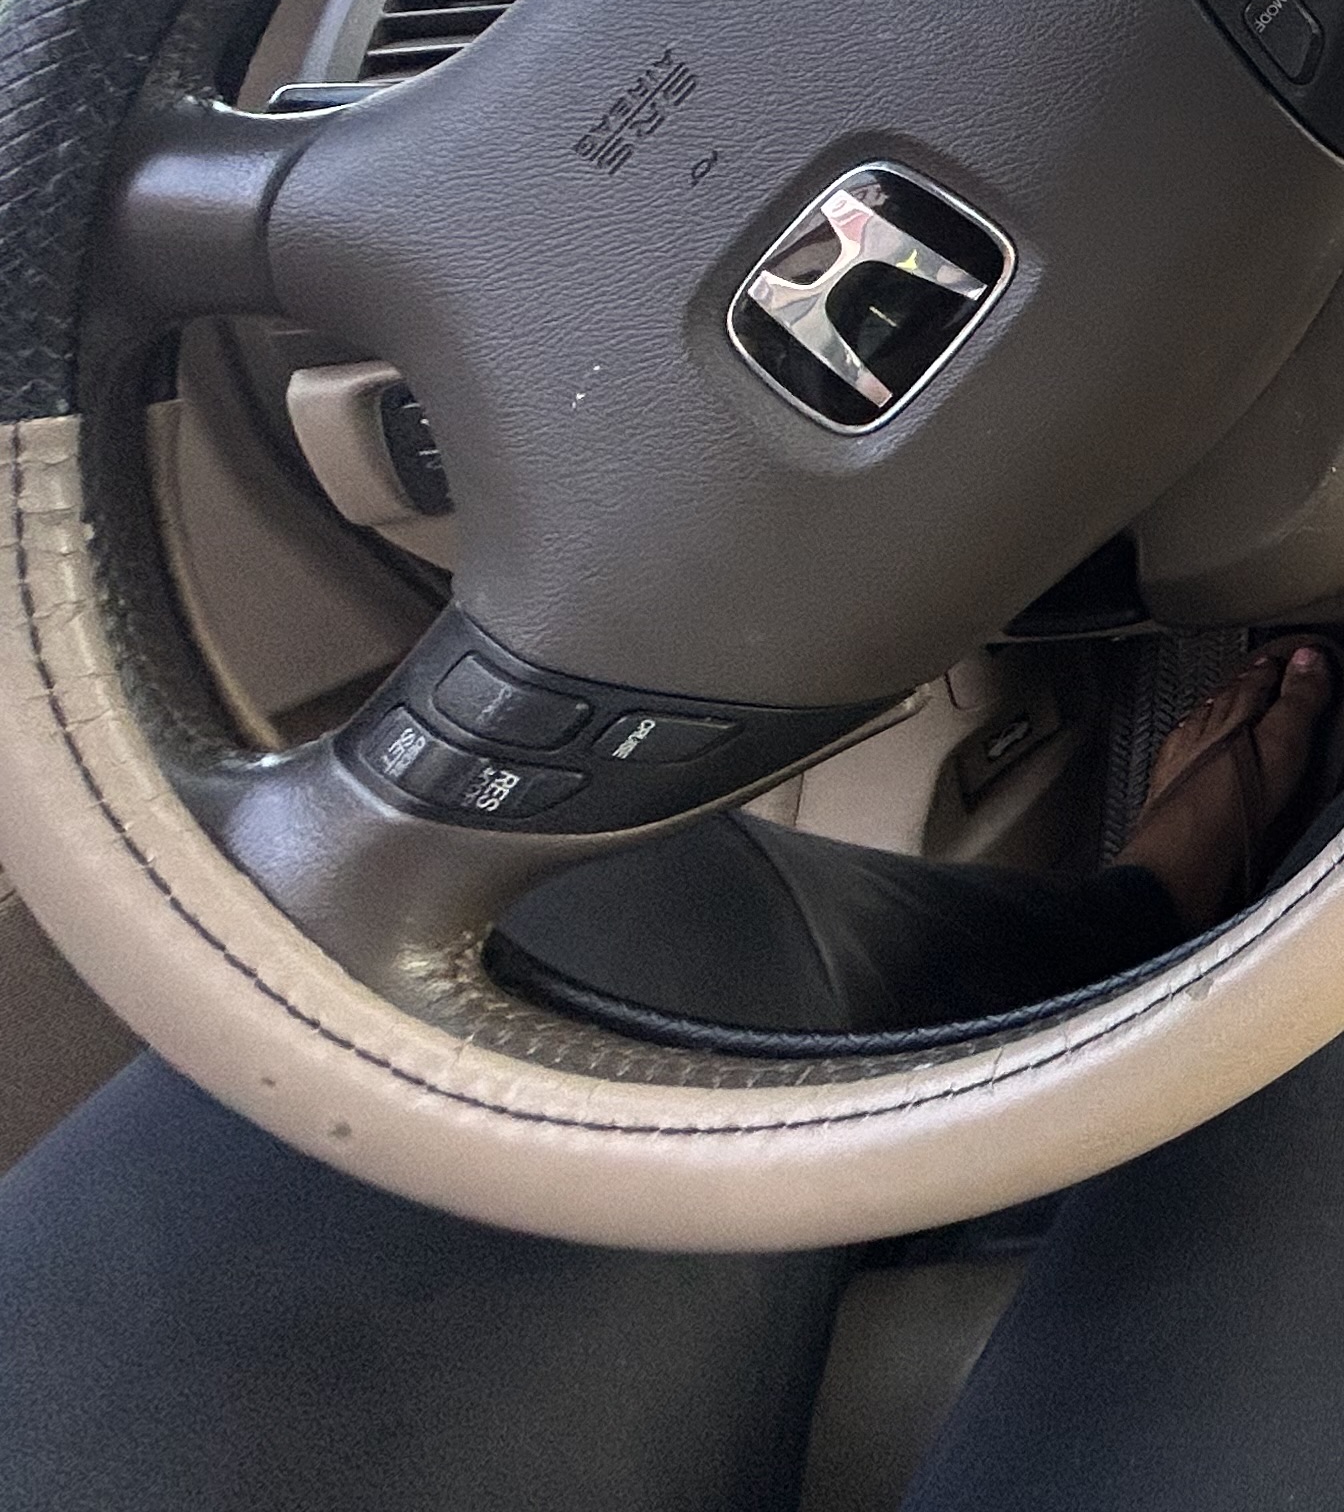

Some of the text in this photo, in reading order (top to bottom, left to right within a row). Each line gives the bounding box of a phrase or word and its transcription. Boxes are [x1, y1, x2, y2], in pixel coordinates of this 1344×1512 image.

[381, 728, 416, 774] SET
[612, 719, 656, 759] CRUISE
[476, 769, 521, 812] RES
